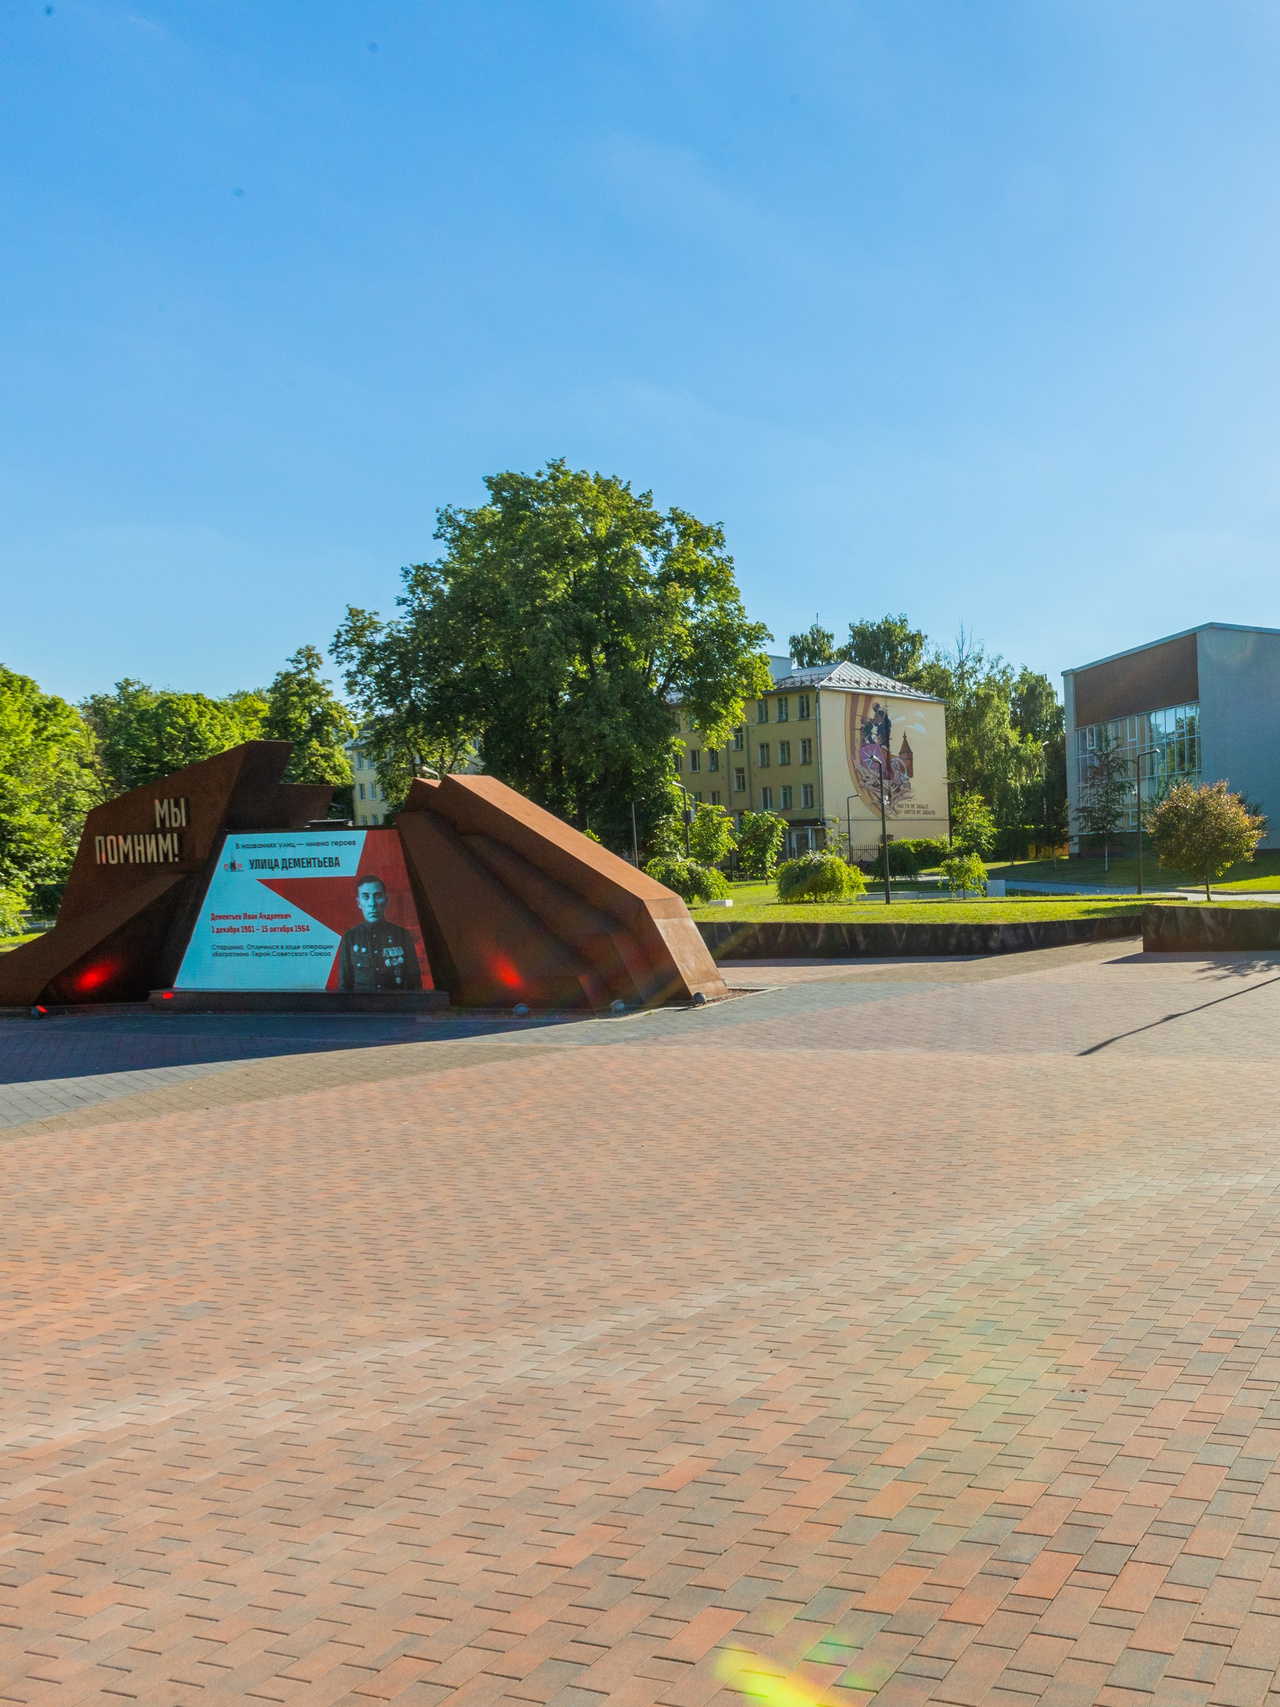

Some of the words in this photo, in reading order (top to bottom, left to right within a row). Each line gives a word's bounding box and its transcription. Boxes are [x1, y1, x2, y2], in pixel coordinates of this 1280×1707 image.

[154, 798, 186, 829] МЫ
[95, 833, 179, 865] ПОМНИМ!
[331, 840, 357, 848] героев
[249, 858, 280, 871] УЛИЦА
[281, 856, 341, 870] ДЕМЕНТЬЕВА
[211, 912, 241, 921] Дементьев
[243, 912, 257, 920] Иван
[259, 912, 291, 920] Андреевич
[216, 926, 240, 934] декабря
[241, 925, 255, 933] 1901
[270, 924, 293, 934] октября
[294, 924, 310, 932] 1964
